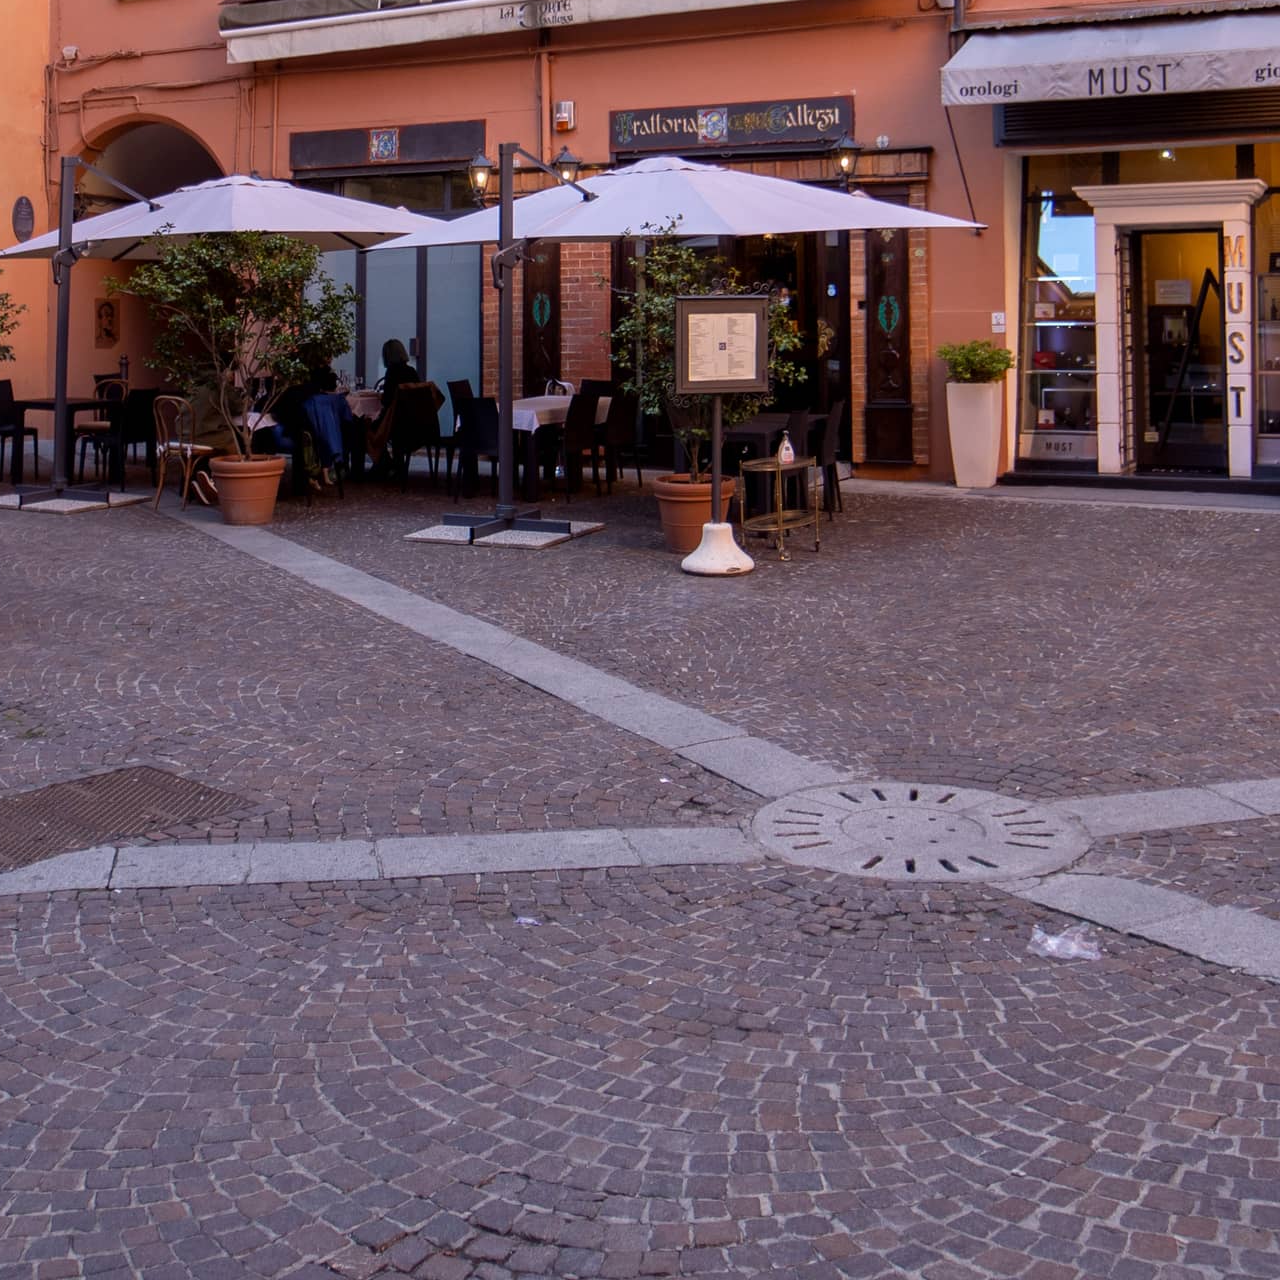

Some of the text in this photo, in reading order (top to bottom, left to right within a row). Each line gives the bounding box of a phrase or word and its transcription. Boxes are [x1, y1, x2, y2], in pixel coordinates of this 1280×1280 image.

[959, 80, 1019, 98] orologi
[1088, 64, 1172, 96] MUST
[1223, 234, 1247, 419] MUST
[1045, 441, 1073, 452] MUST
